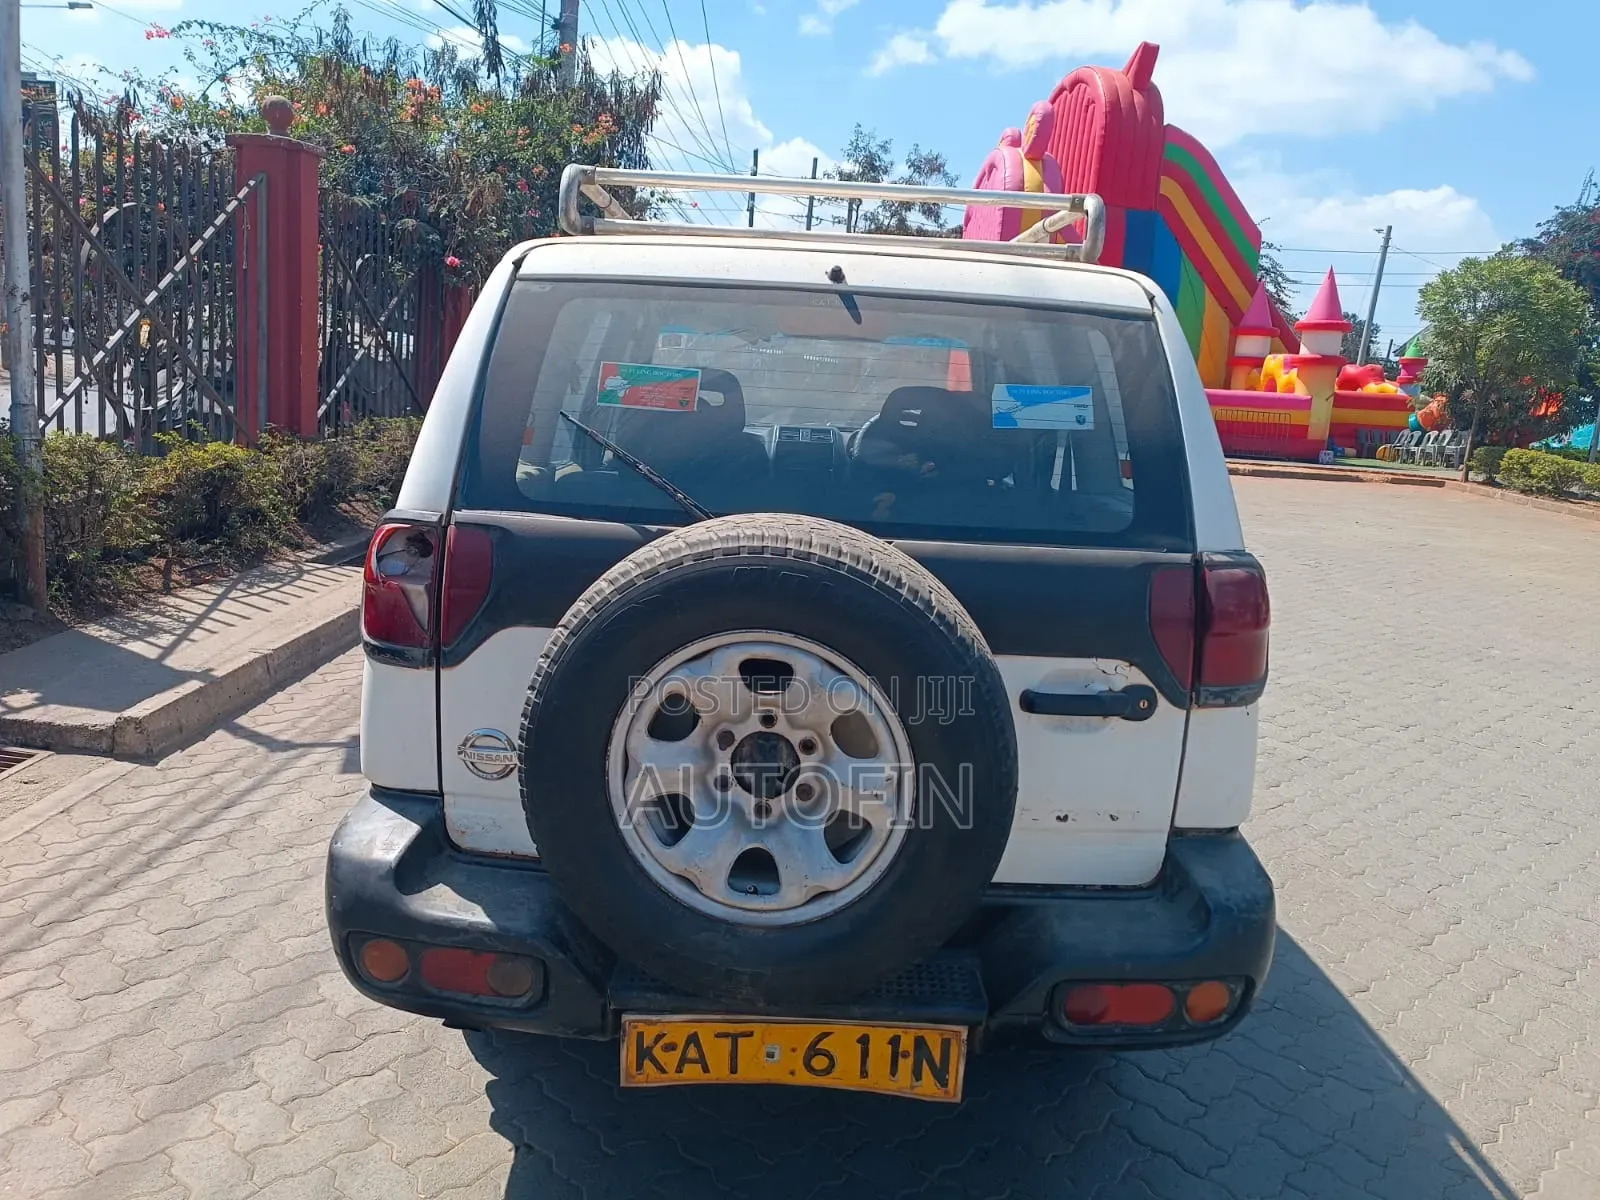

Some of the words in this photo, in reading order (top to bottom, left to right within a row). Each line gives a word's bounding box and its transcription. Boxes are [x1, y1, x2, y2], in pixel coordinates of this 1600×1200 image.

[463, 751, 514, 763] NISSAN
[635, 1029, 754, 1076] KAT
[802, 1031, 951, 1090] 611N
